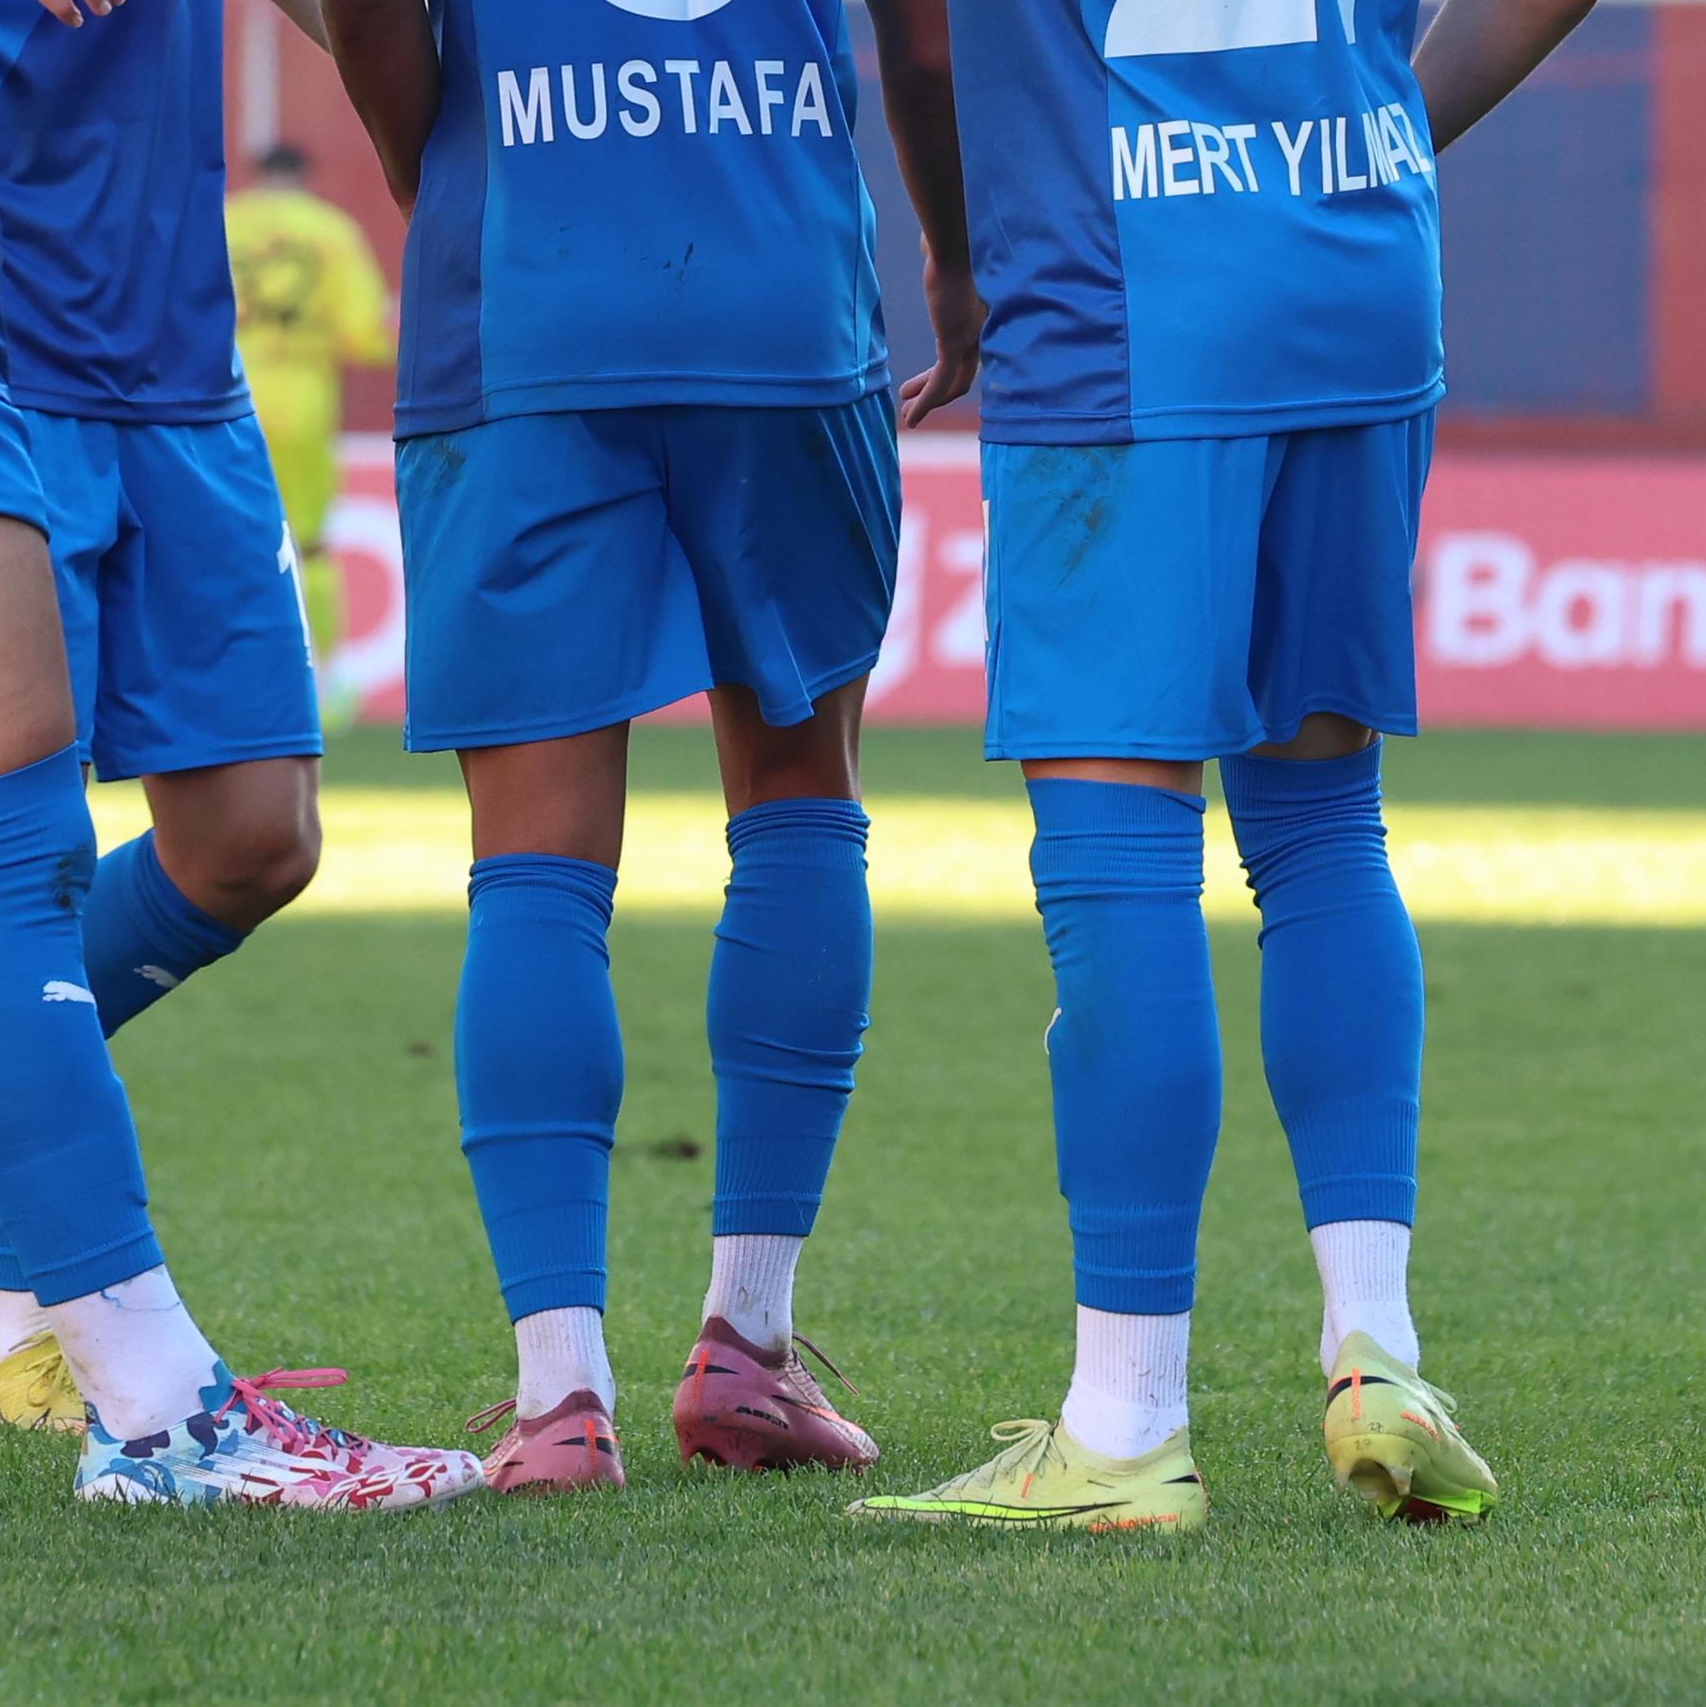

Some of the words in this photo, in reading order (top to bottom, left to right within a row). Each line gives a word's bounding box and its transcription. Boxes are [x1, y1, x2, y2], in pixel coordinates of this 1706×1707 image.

[497, 58, 834, 148] MUSTAFA
[1111, 120, 1259, 201] MERT
[1271, 102, 1431, 197] YILMAZ
